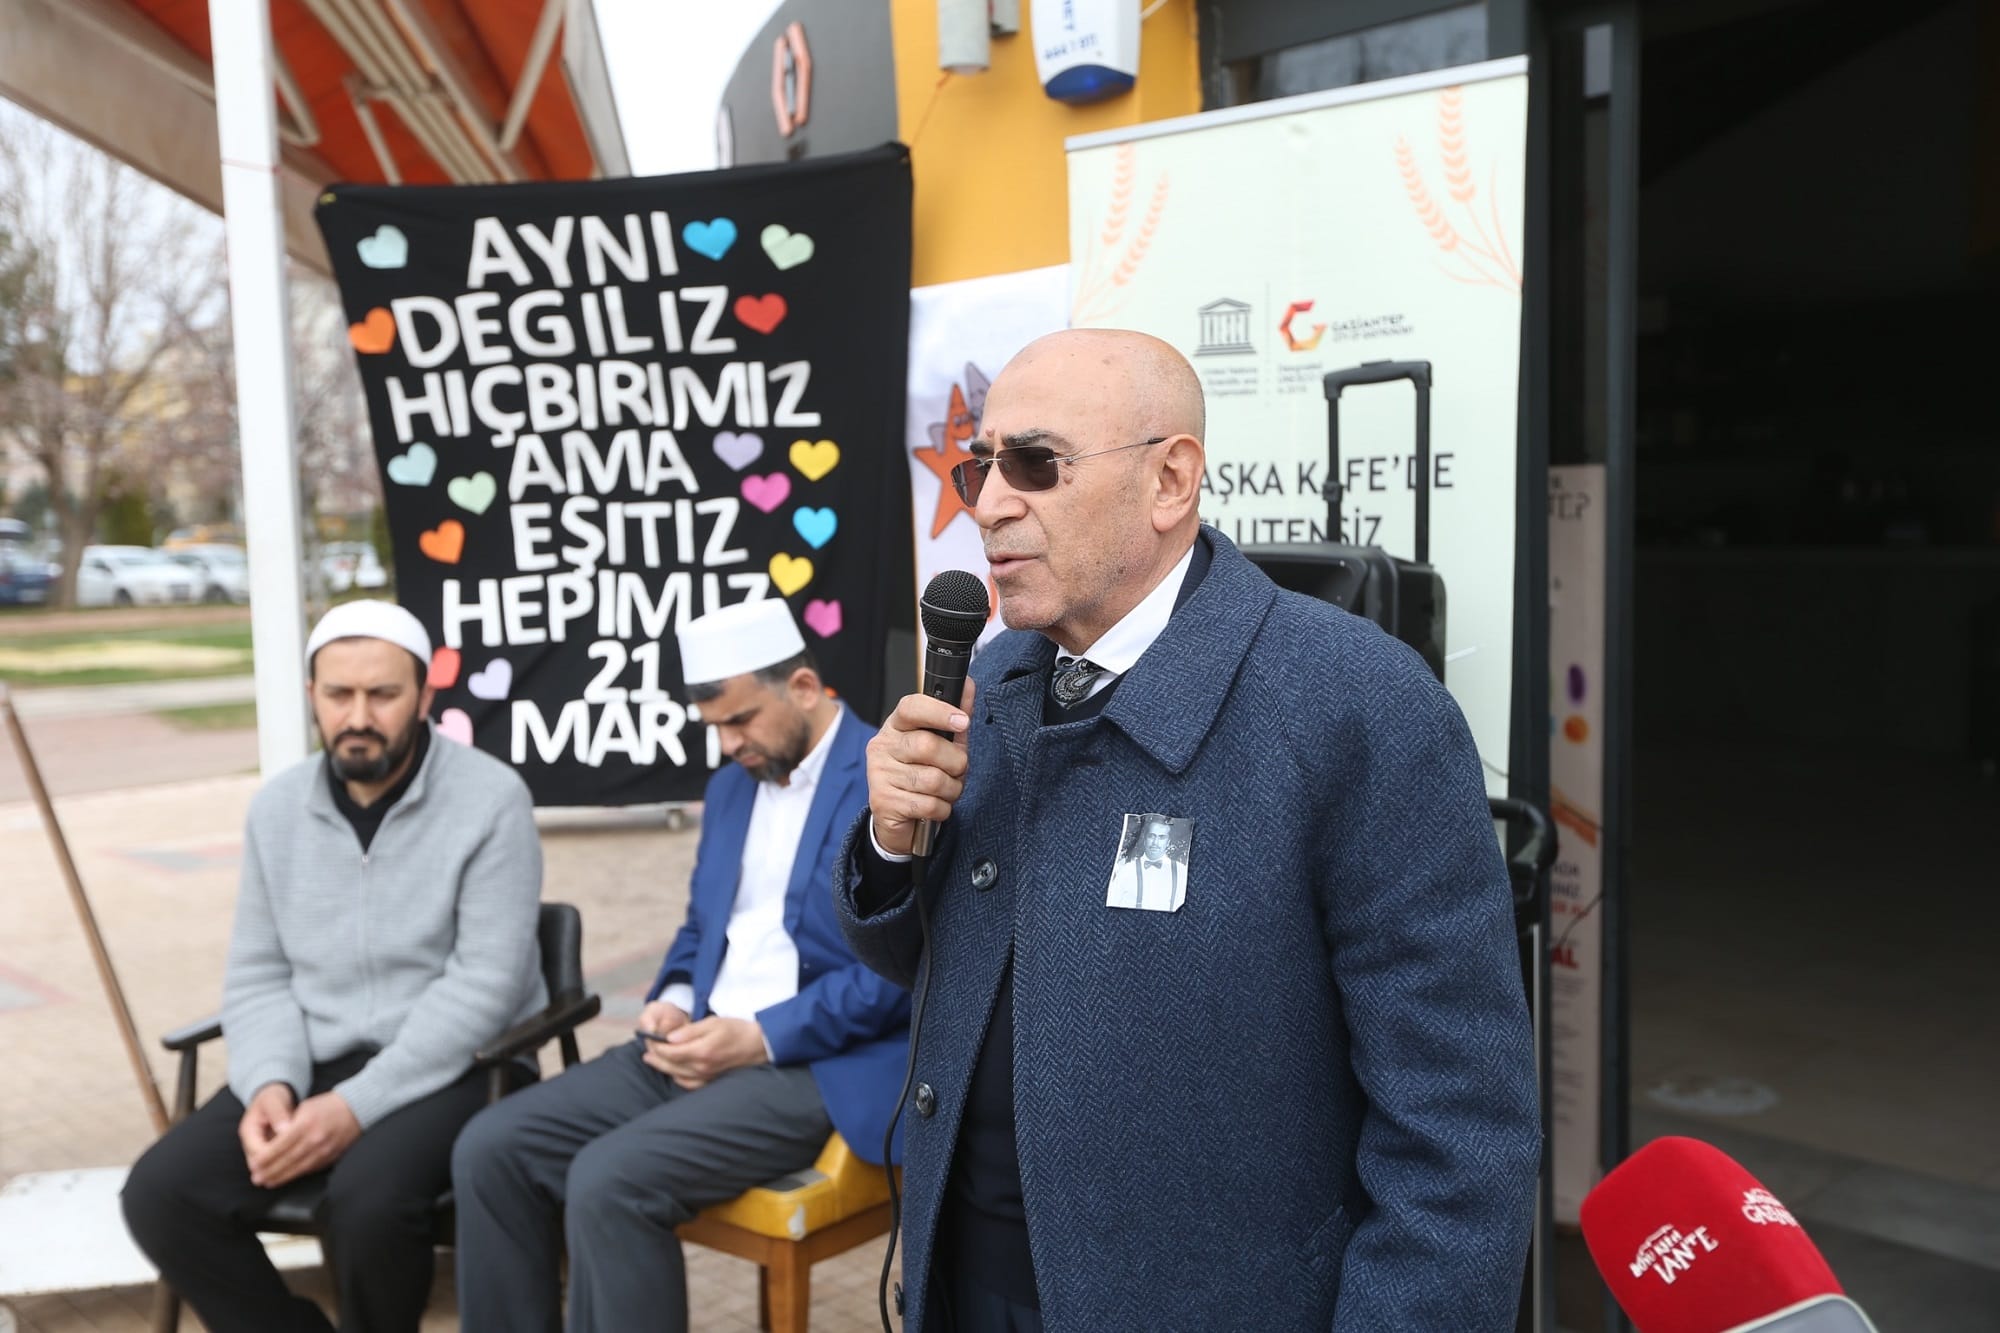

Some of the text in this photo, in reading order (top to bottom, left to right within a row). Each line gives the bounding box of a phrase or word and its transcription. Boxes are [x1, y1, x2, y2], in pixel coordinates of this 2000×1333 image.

[467, 211, 678, 289] AYNI
[391, 286, 737, 369] DEGILIZ
[386, 360, 822, 448] HIÇBIRIMIZ
[508, 429, 700, 502] AMA
[1200, 461, 1283, 505] AŞKA
[510, 496, 749, 579] EŞITIZ
[583, 639, 671, 704] 21
